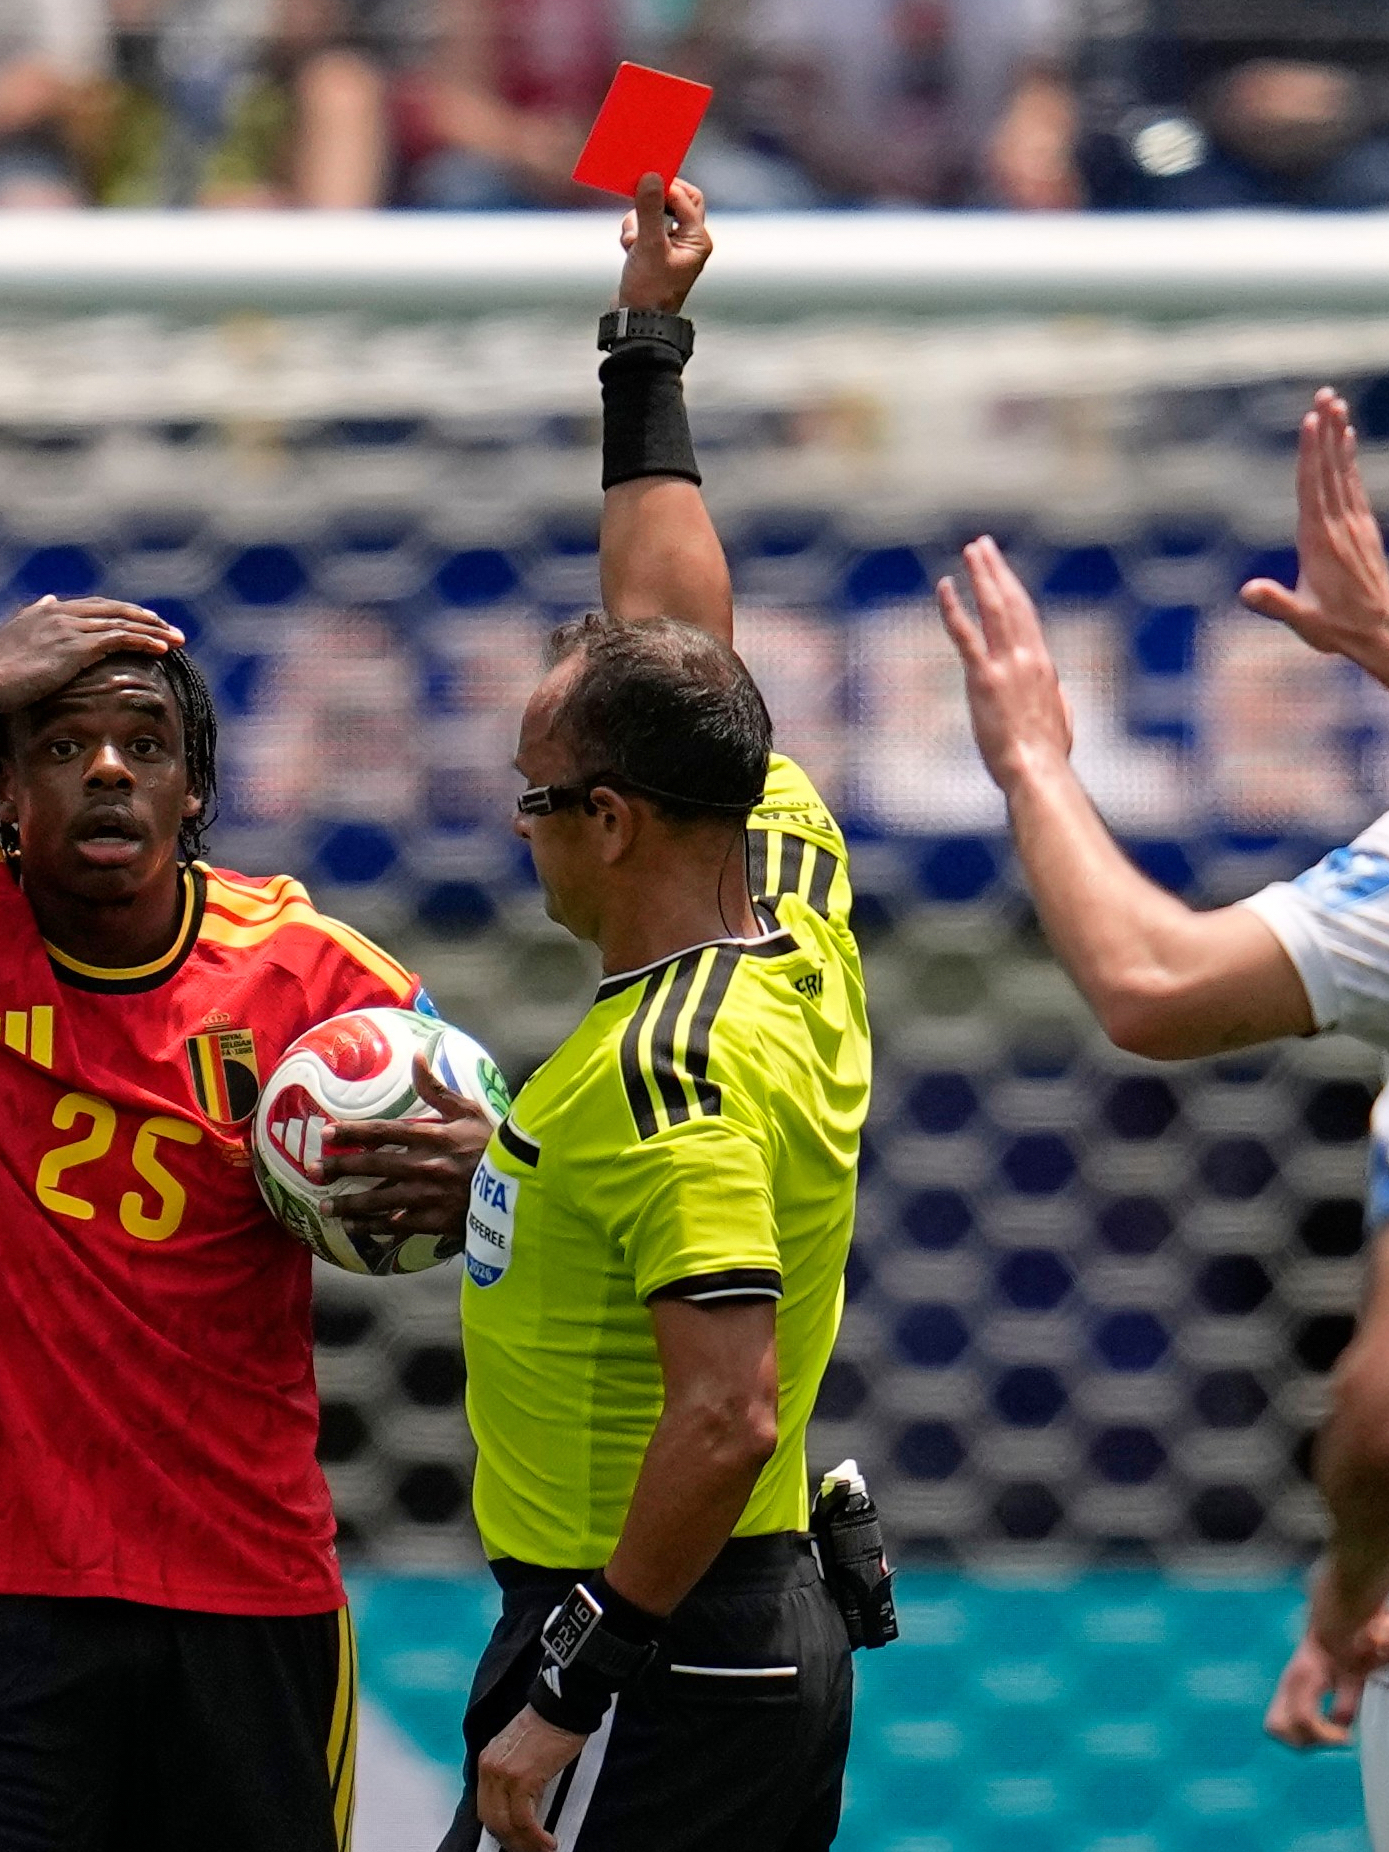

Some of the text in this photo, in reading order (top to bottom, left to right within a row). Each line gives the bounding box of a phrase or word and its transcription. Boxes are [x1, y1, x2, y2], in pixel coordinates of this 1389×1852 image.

[36, 1091, 203, 1241] 25
[473, 1163, 508, 1214] FIFA
[468, 1258, 494, 1282] 2026
[551, 1601, 590, 1658] 92:16
